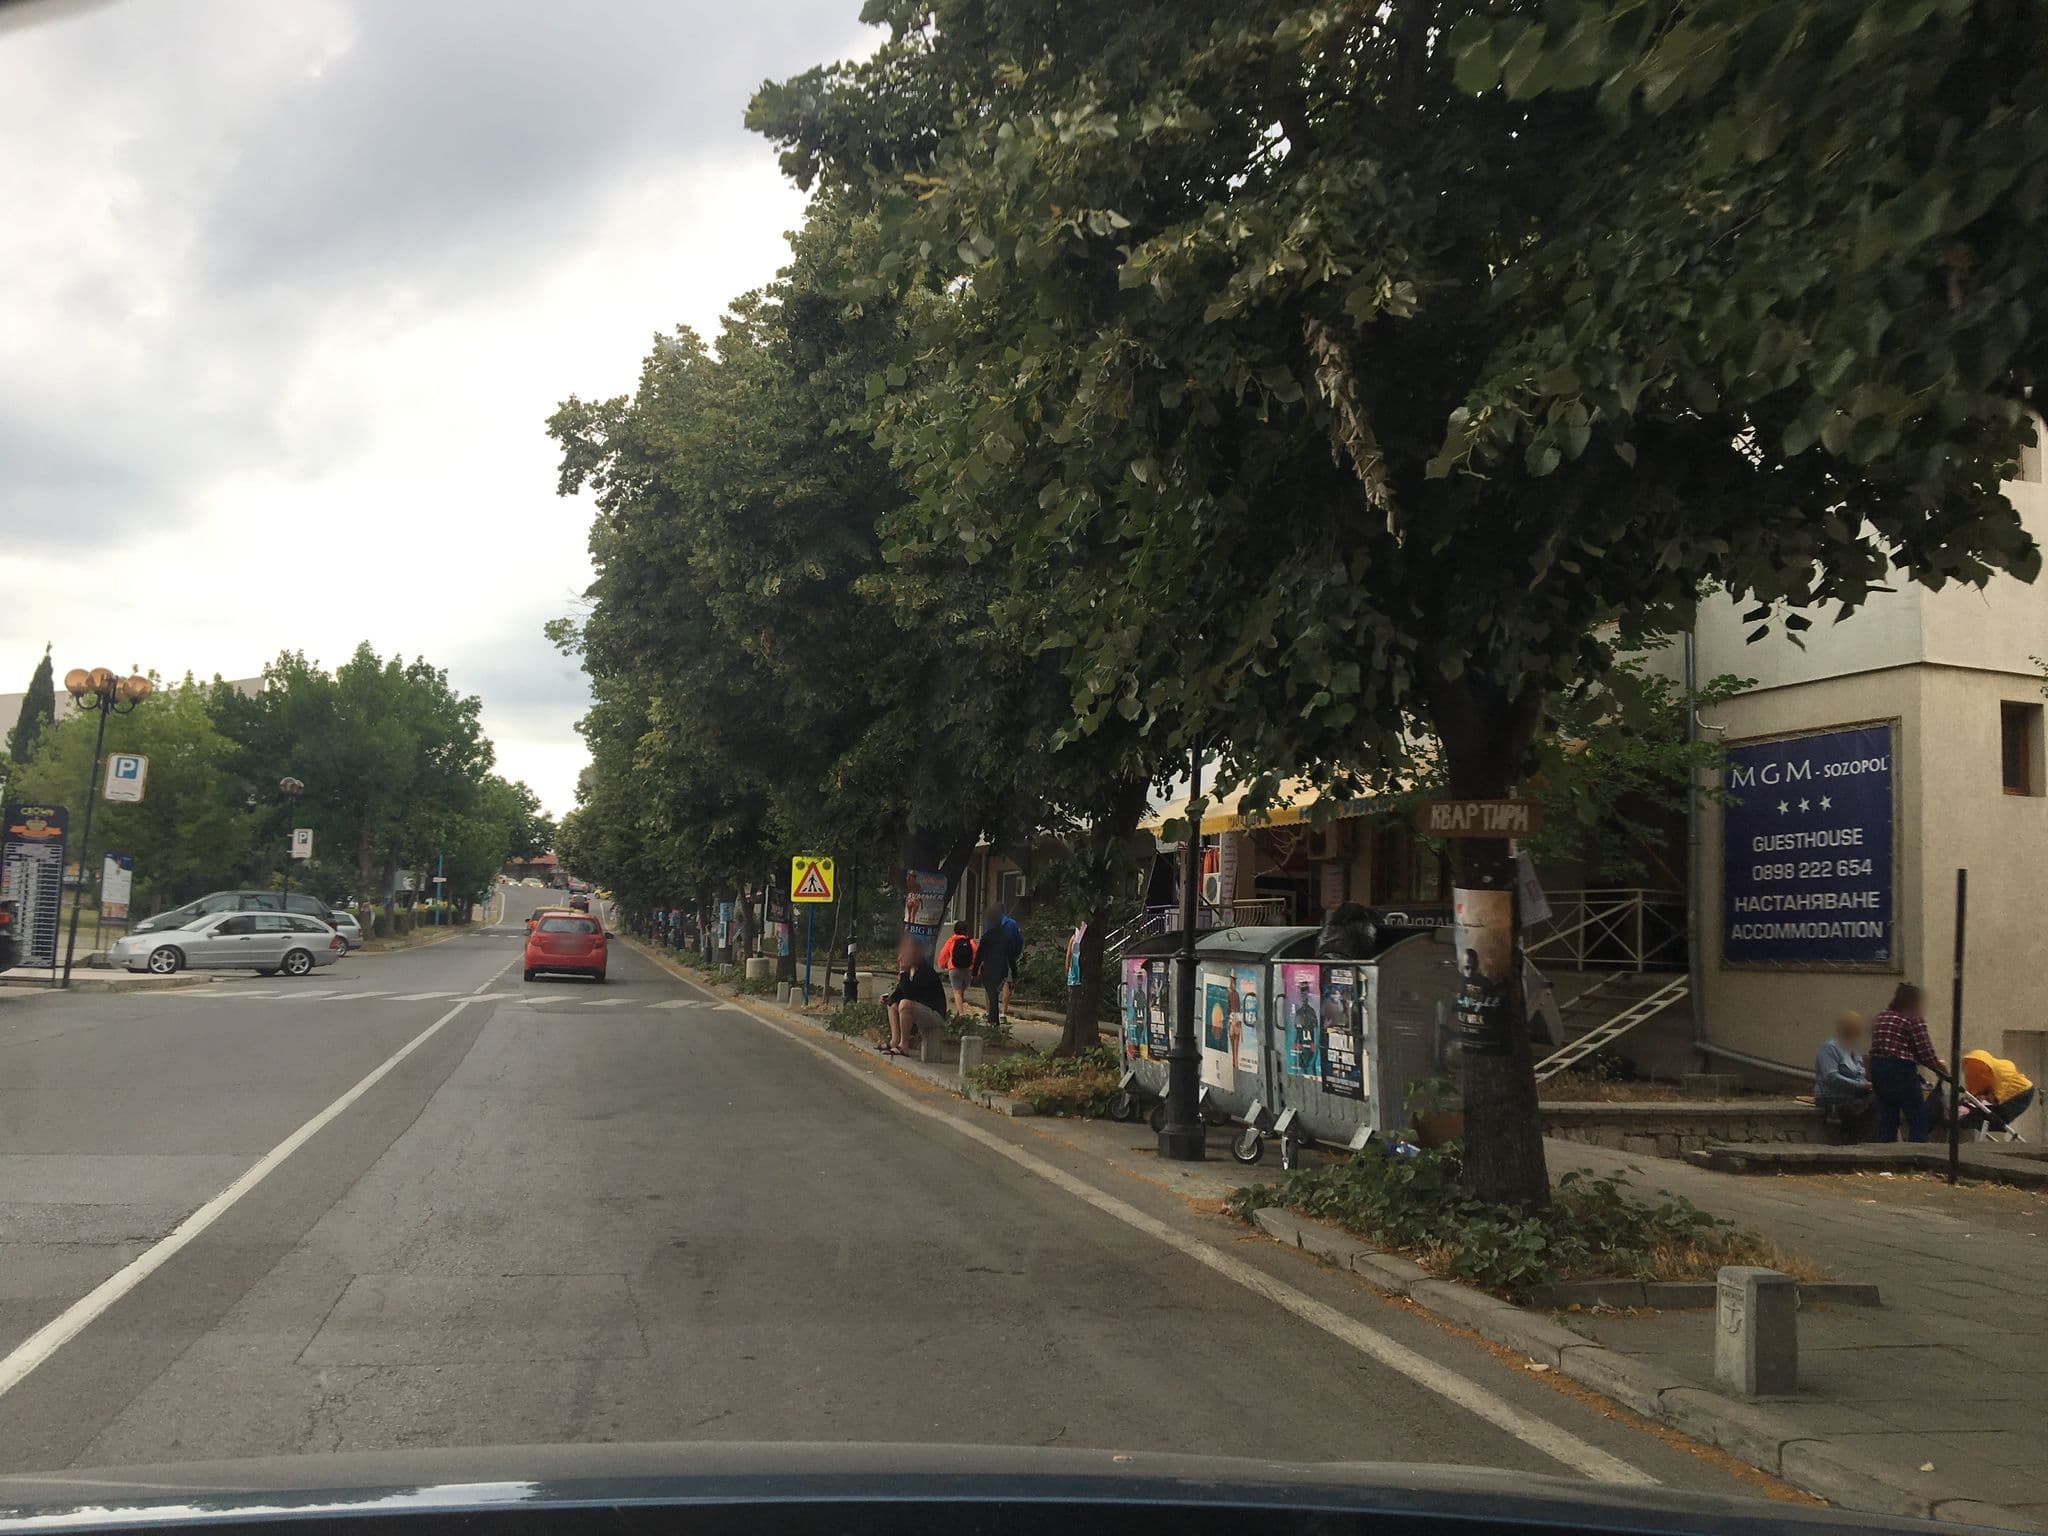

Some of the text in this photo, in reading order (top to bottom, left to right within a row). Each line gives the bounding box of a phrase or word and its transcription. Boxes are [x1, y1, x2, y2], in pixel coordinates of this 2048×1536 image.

[118, 759, 136, 778] P
[1731, 759, 1812, 788] MGM
[1824, 757, 1888, 778] SOZOPOL
[1752, 828, 1863, 852] GUESTHOUSE
[1752, 858, 1873, 881] 0898 222 654
[1735, 891, 1880, 912] НАСТАНЯВАНЕ
[1731, 920, 1883, 940] ACCOMMODATION
